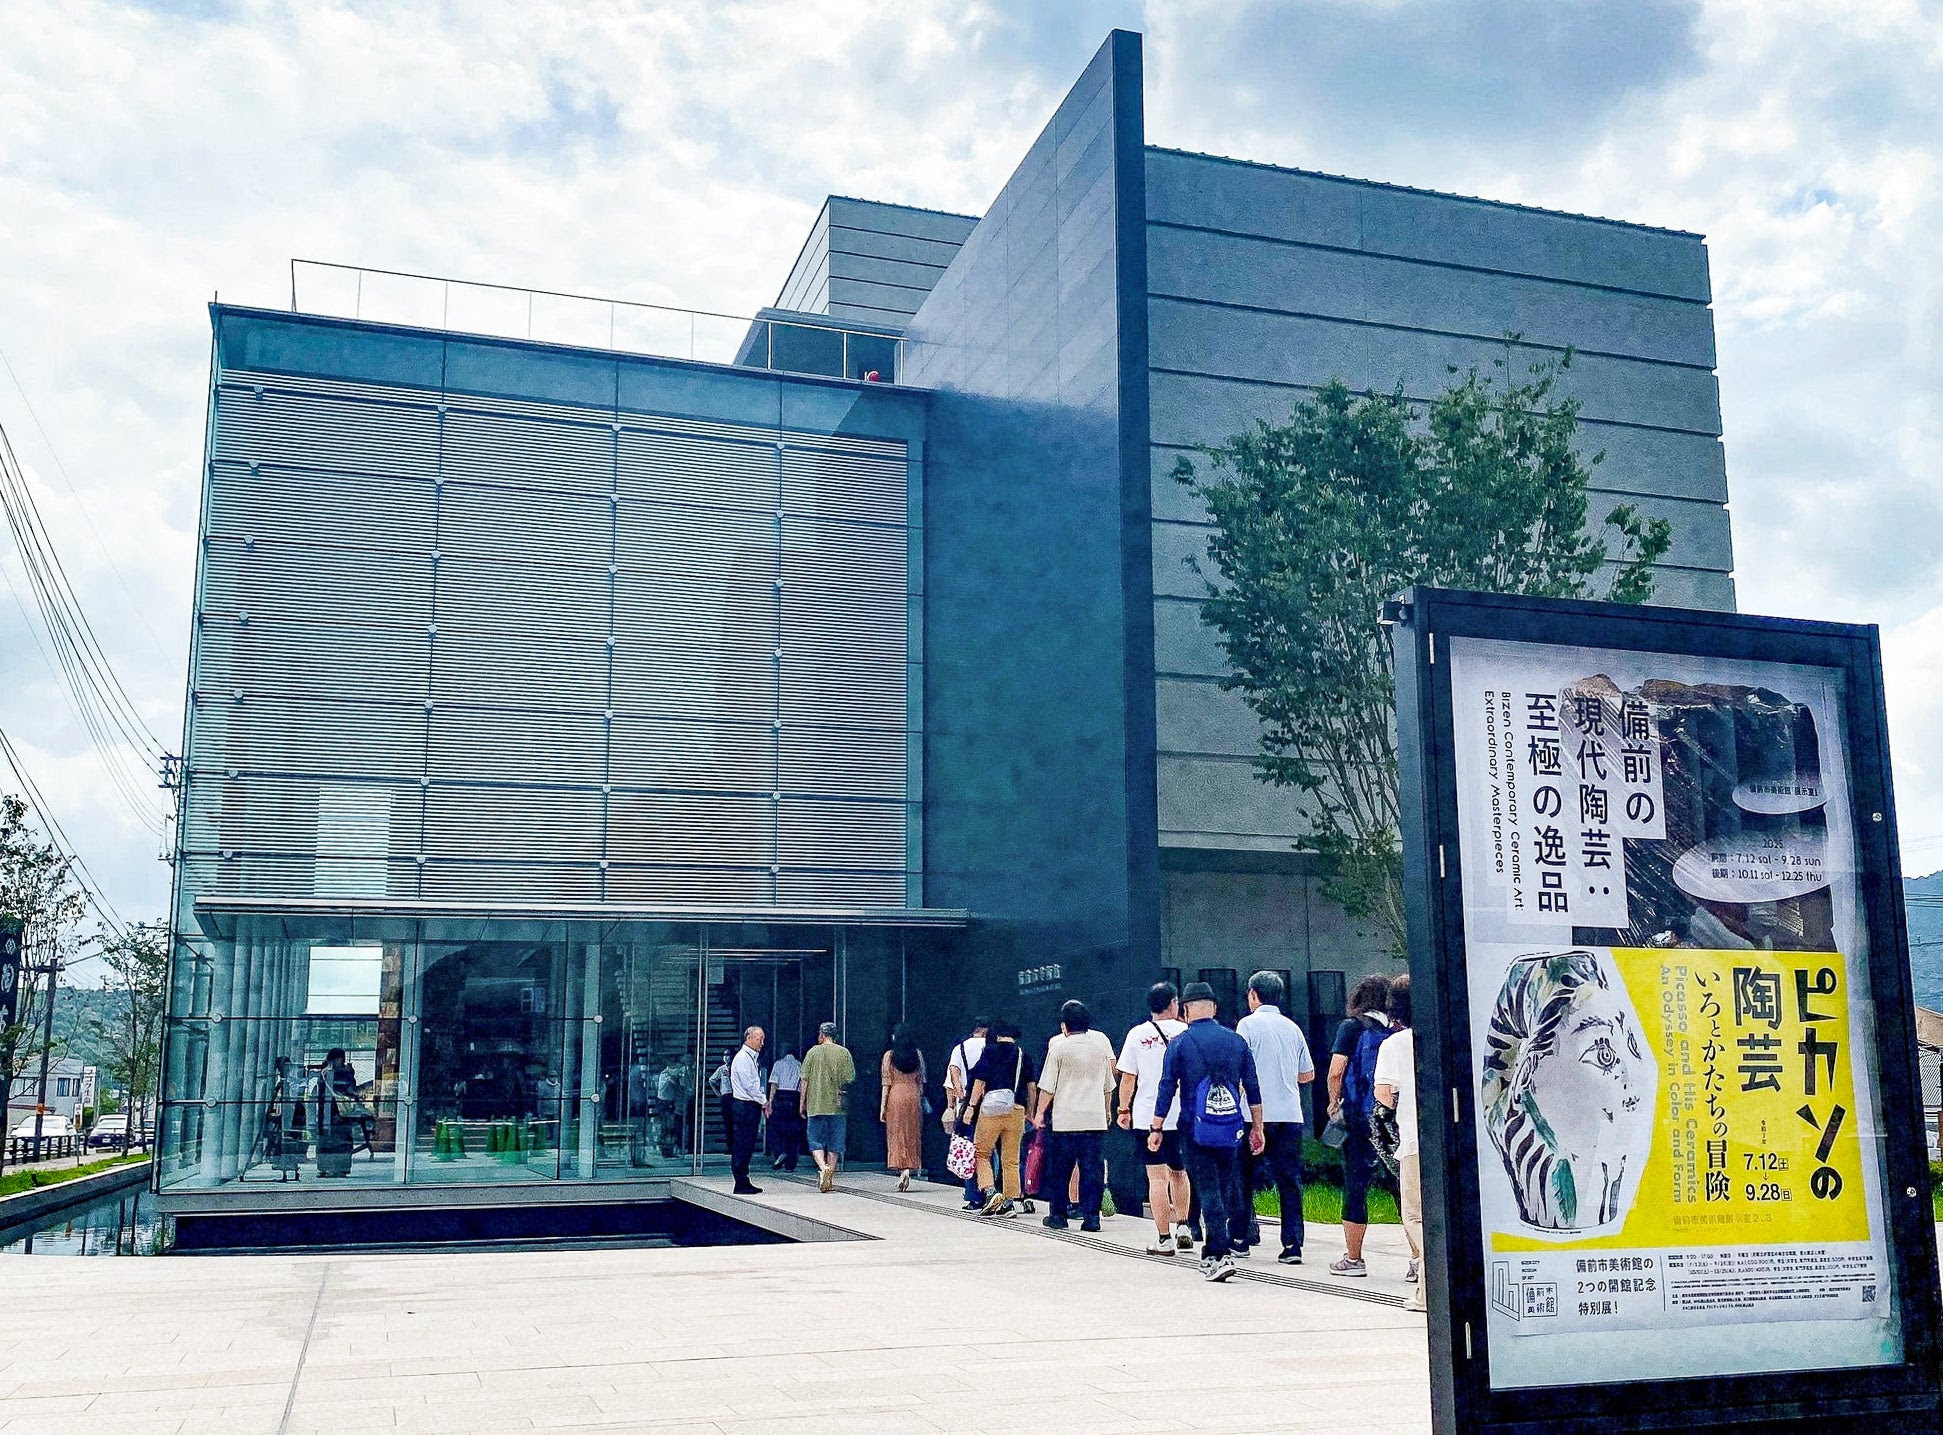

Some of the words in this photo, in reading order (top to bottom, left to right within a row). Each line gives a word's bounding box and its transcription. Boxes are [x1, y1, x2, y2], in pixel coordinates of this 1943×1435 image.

[1501, 691, 1511, 727] Bizen
[1485, 690, 1499, 780] Extraordinary
[1504, 731, 1518, 826] Contemporary
[1619, 700, 1655, 825] 備前の
[1525, 692, 1568, 913] 至極の逸品
[1491, 784, 1504, 873] Masterpieces
[1511, 831, 1521, 884] Ceramic
[1782, 871, 1804, 881] 12.25
[1806, 872, 1822, 882] thu
[1805, 858, 1821, 866] sun
[1514, 887, 1525, 911] Art:
[1661, 965, 1670, 985] An
[1675, 966, 1687, 1032] Picasso
[1661, 991, 1674, 1058] Odyssey
[1733, 966, 1784, 1092] 陶芸
[1668, 1063, 1678, 1076] in
[1680, 1040, 1696, 1075] and
[1670, 1082, 1681, 1122] Color
[1684, 1083, 1696, 1111] His
[1695, 971, 1731, 1201] いろとかたちの冒険
[1795, 967, 1846, 1201] ピカソの
[1673, 1129, 1684, 1158] and
[1686, 1119, 1700, 1203] Ceramics
[1674, 1164, 1684, 1203] Form
[1576, 1257, 1653, 1273] 備前市美術館の
[1578, 1278, 1656, 1294] 2つの開館記念
